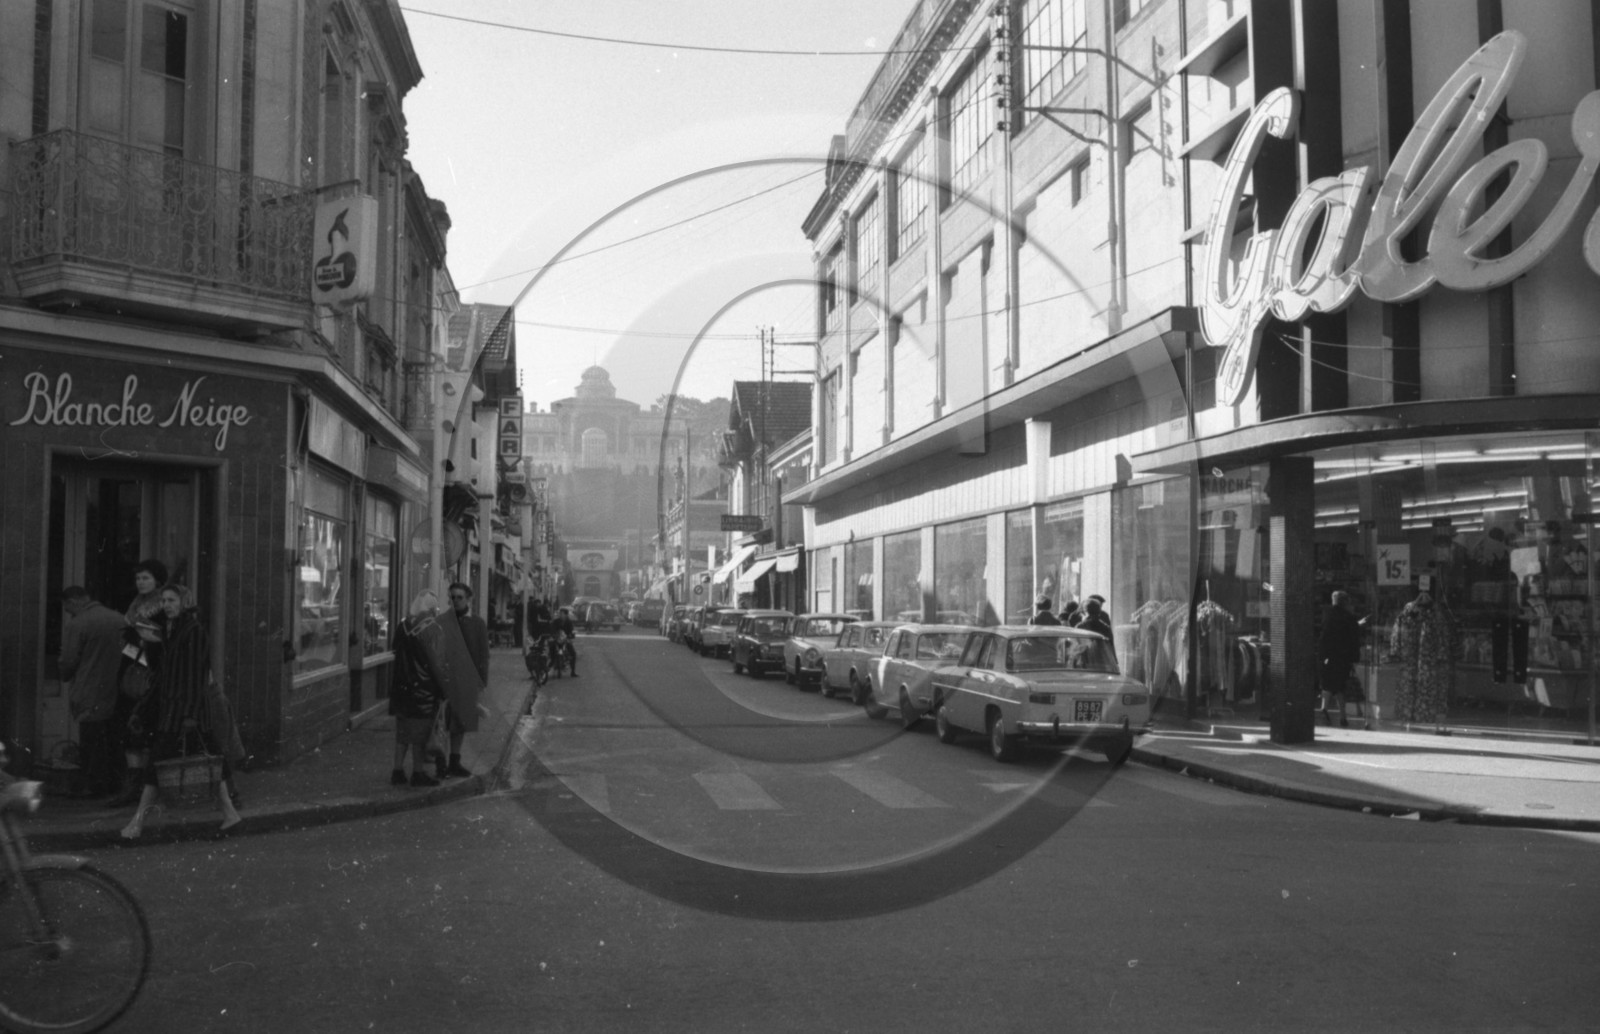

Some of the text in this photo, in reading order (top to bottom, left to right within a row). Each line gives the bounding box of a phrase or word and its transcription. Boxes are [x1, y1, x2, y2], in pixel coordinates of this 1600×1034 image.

[9, 371, 252, 451] Blanche Neige
[502, 400, 519, 454] FAR
